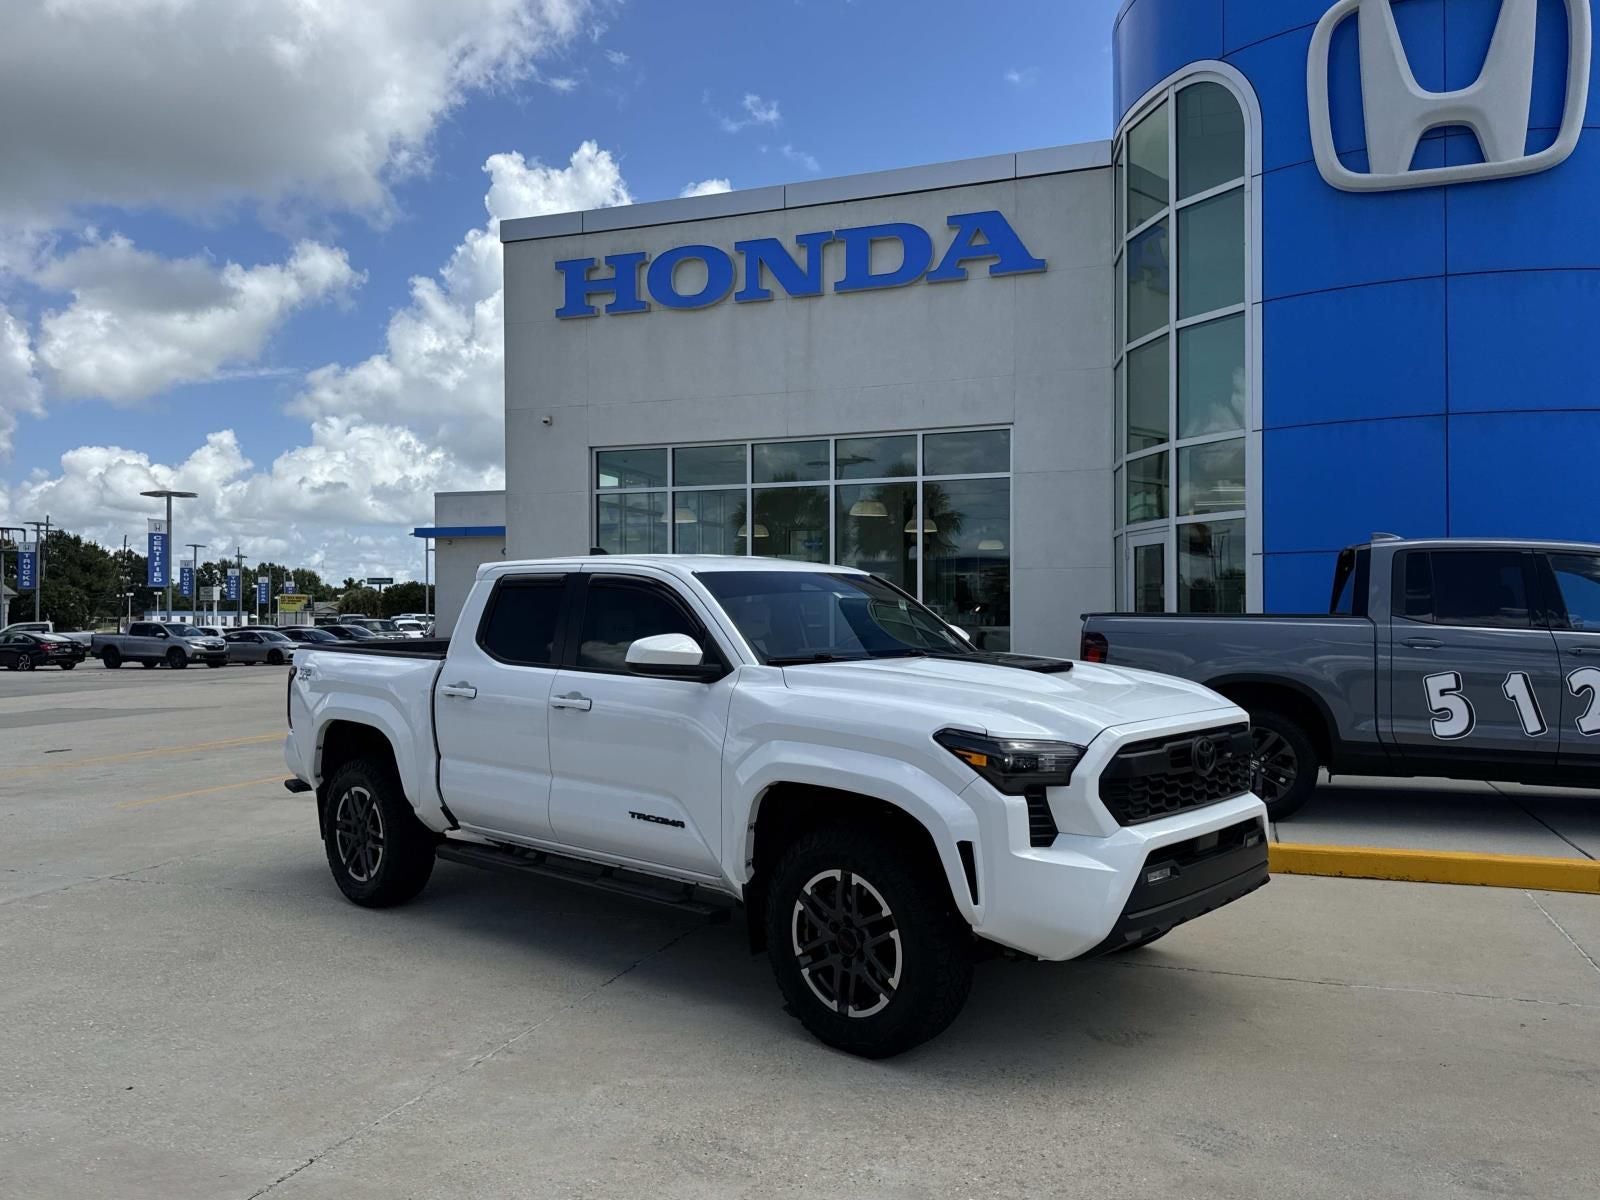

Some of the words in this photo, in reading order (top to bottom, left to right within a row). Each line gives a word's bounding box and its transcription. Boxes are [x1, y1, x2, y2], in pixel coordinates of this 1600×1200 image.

[555, 210, 1047, 319] HONDA
[22, 553, 31, 586] TRUCKS
[153, 535, 163, 583] CERTIFIED
[628, 811, 685, 828] TACOMA
